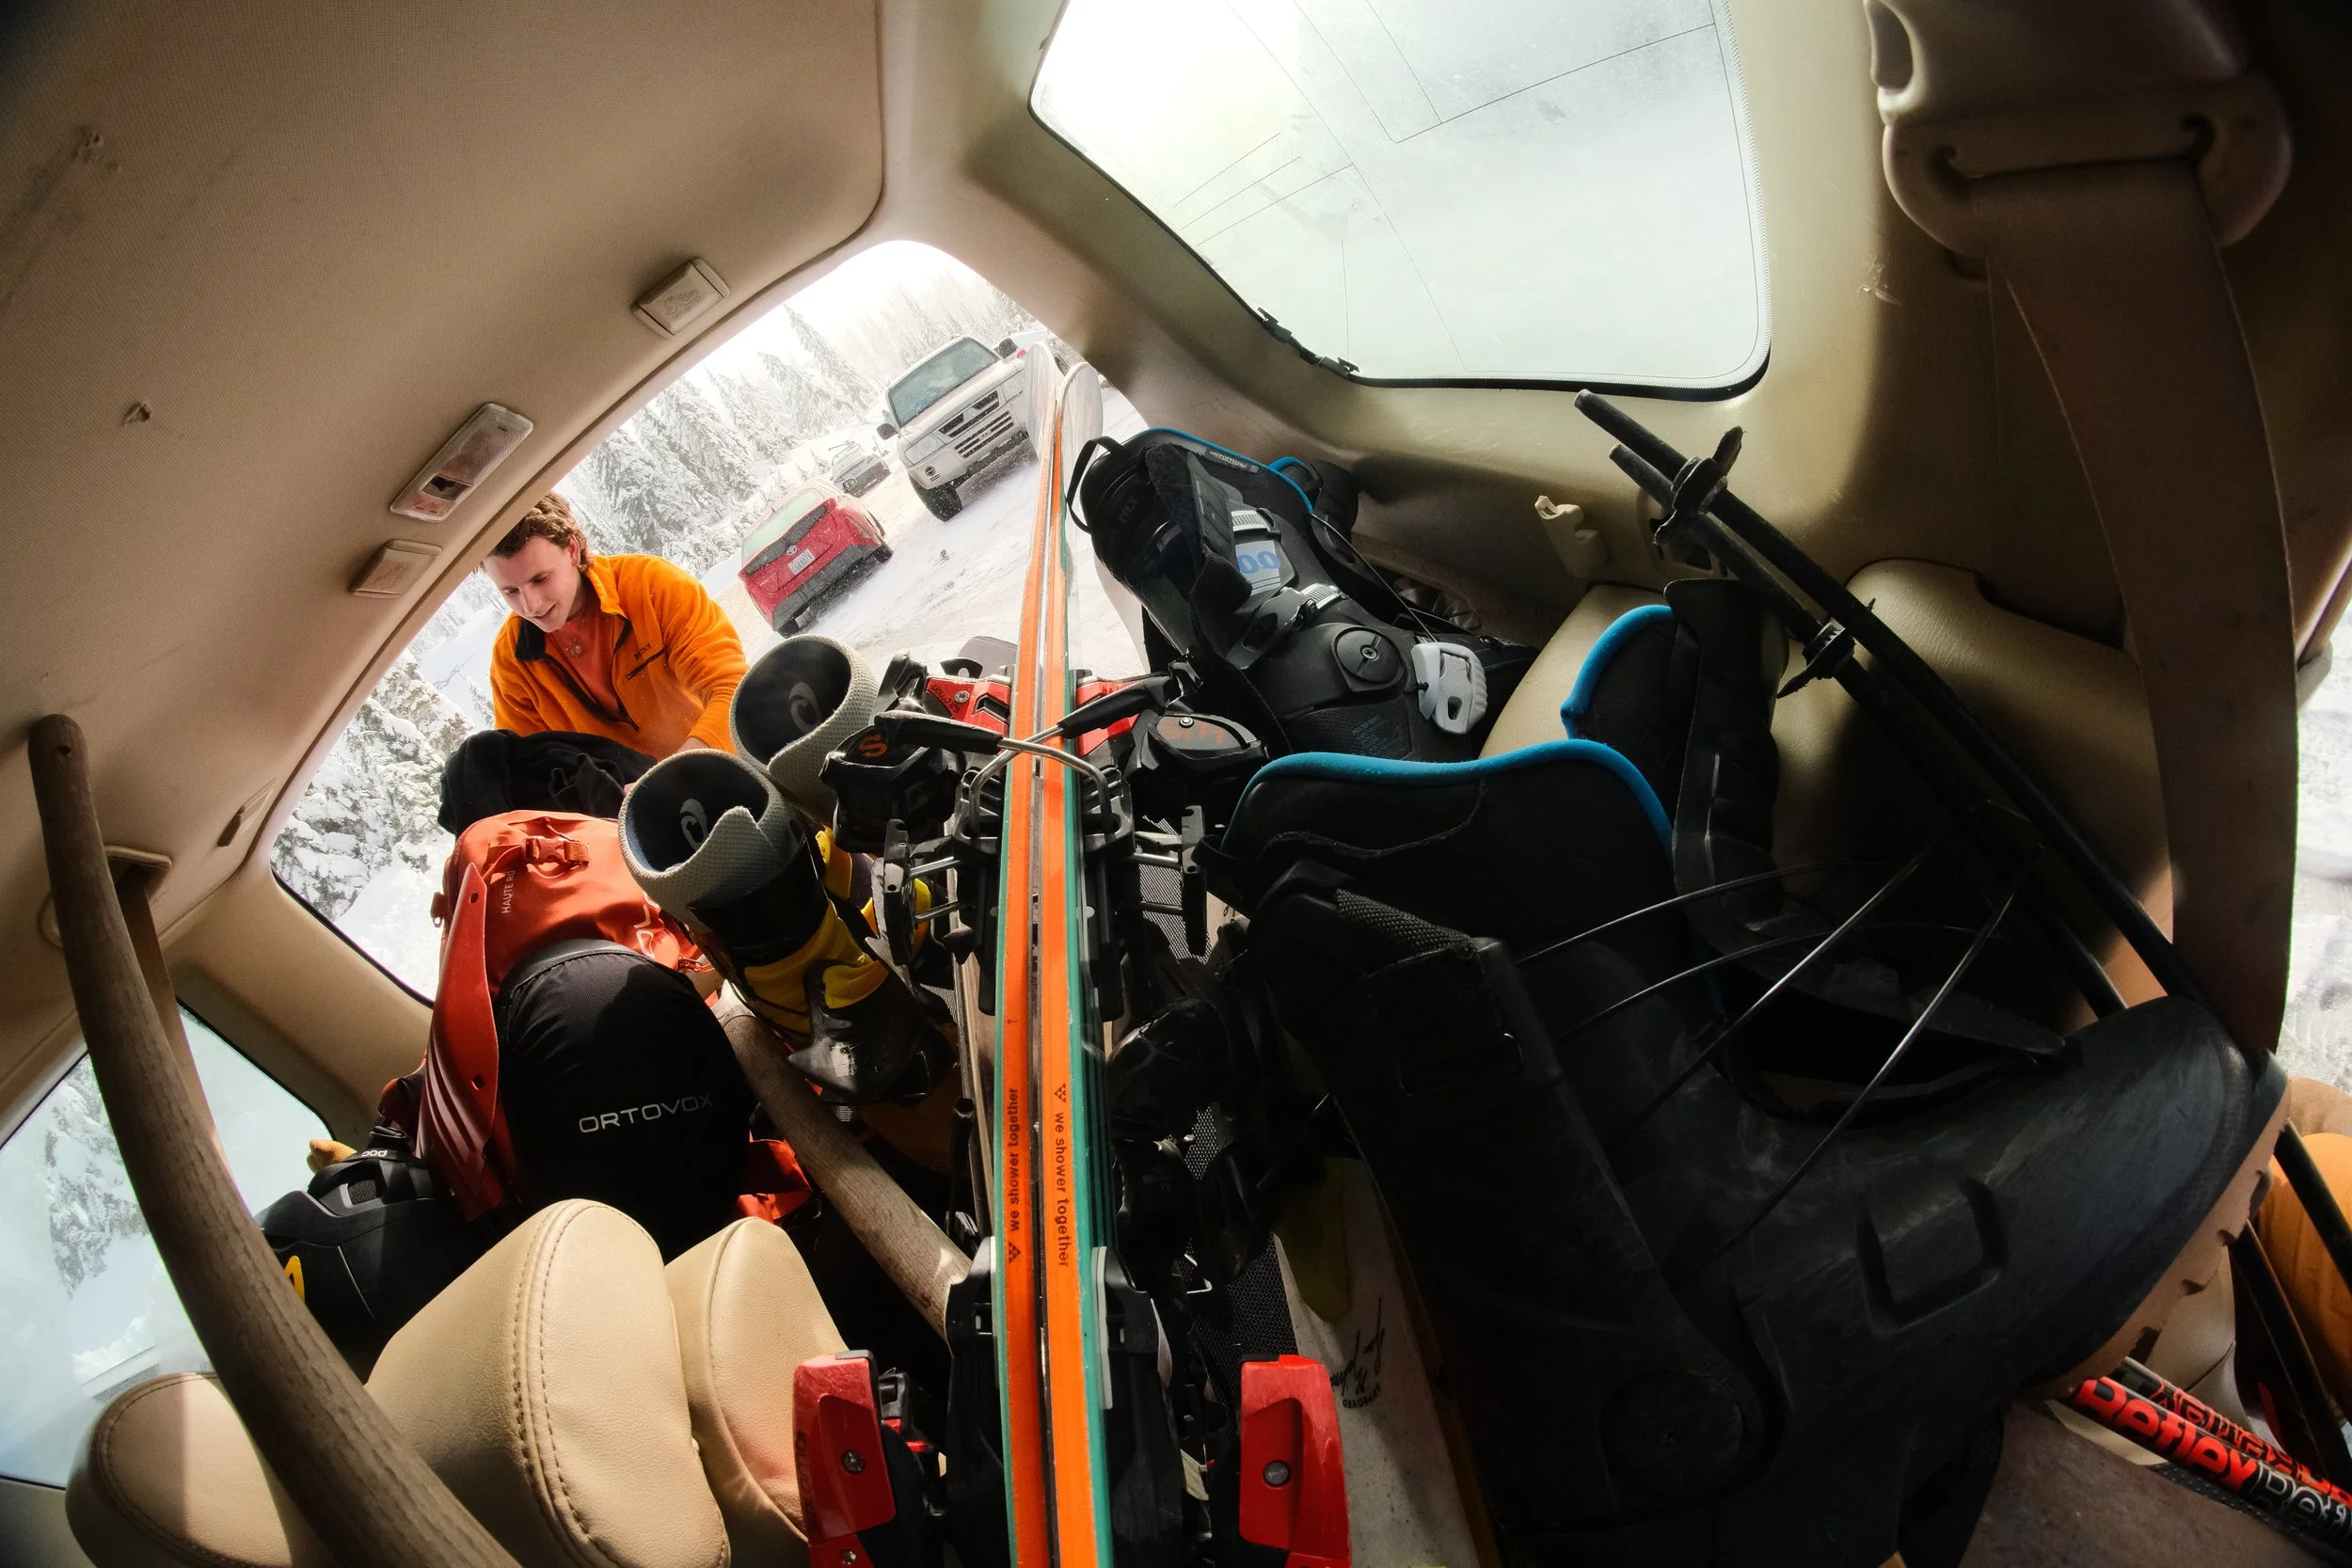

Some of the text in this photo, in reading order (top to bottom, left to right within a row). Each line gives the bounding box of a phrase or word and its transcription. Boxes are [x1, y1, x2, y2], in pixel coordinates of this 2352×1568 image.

[501, 882, 514, 913] HAUTE
[579, 1093, 713, 1132] ORTOVOX
[1007, 1087, 1020, 1232] we shower together
[1055, 1112, 1072, 1268] we shower together
